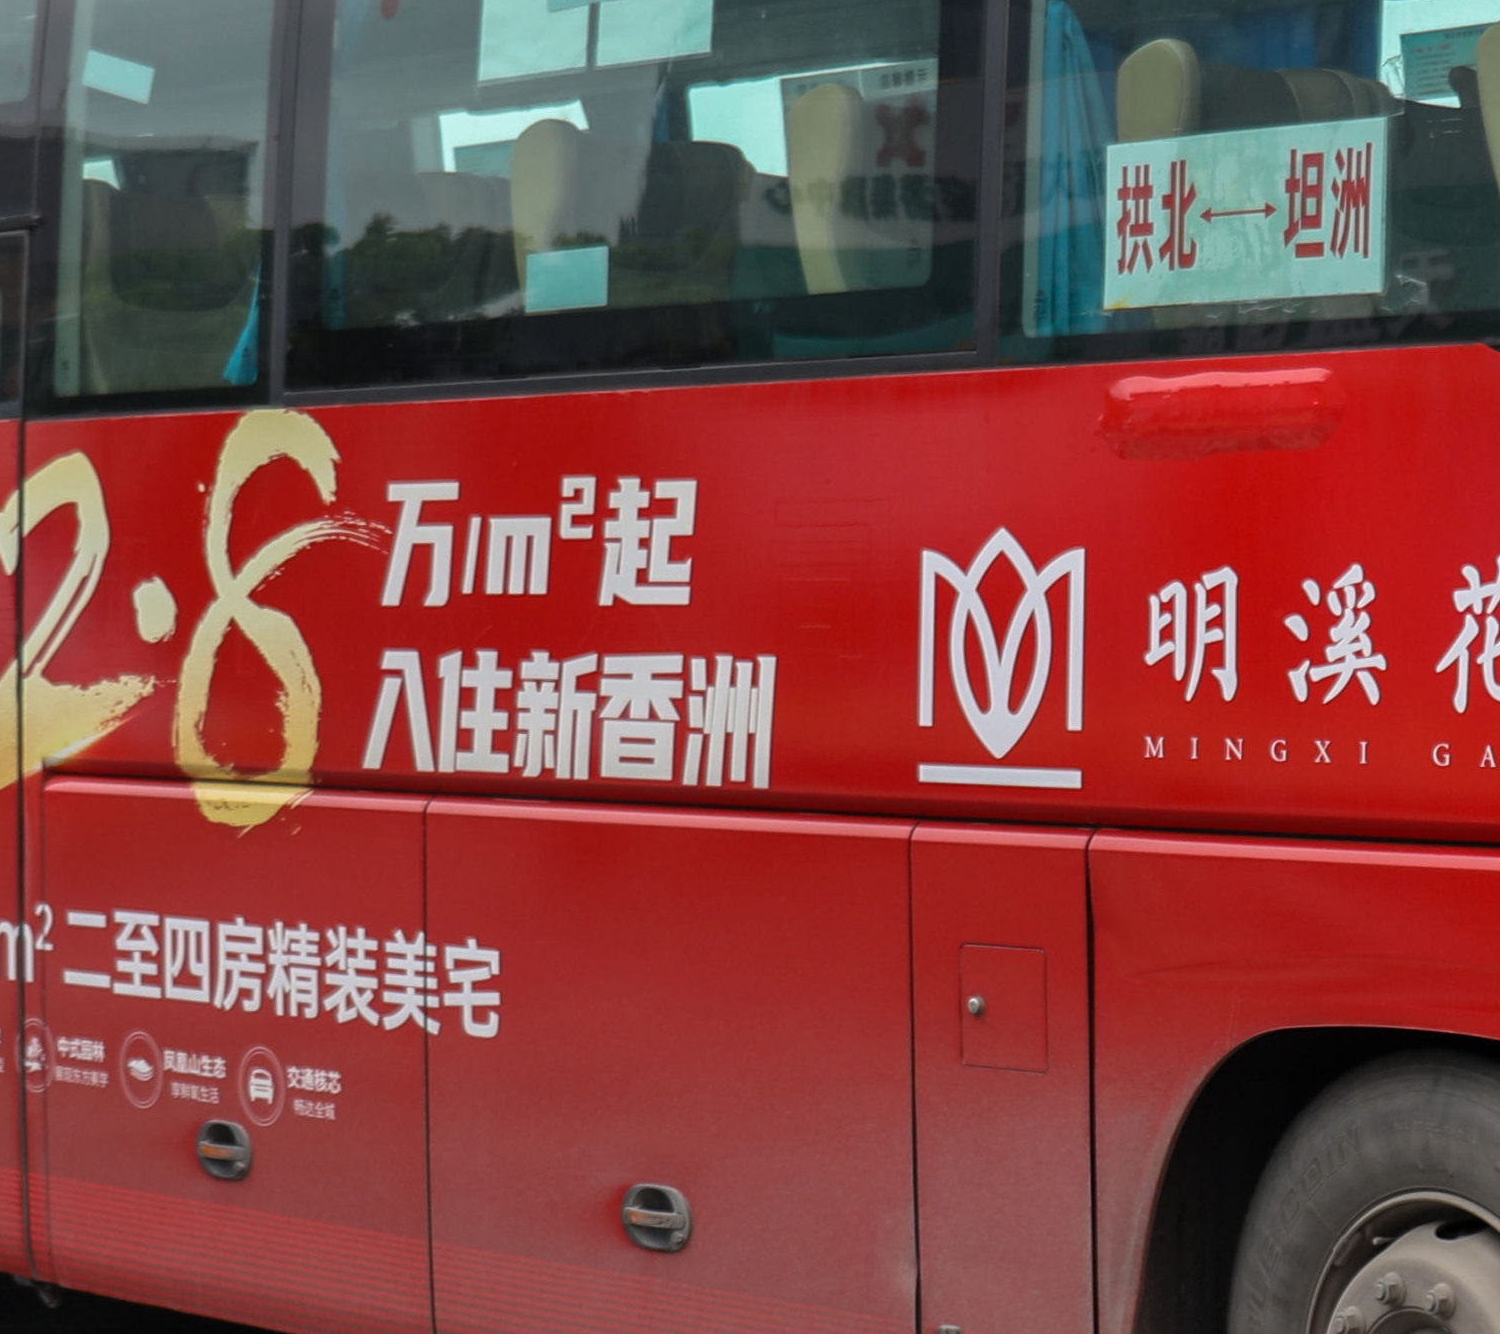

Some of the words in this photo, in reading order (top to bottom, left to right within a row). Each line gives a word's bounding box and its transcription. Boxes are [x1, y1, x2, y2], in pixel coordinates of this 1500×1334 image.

[1117, 160, 1197, 274] 拱北
[1284, 142, 1372, 259] 坦洲
[362, 649, 777, 790] 入住新香洲
[1144, 735, 1369, 765] MINGXI
[63, 906, 501, 1040] 二至四房精装美宅
[57, 1036, 106, 1063] 中式园林
[163, 1049, 227, 1079] 凤凰山生态
[286, 1066, 342, 1095] 交通核芯
